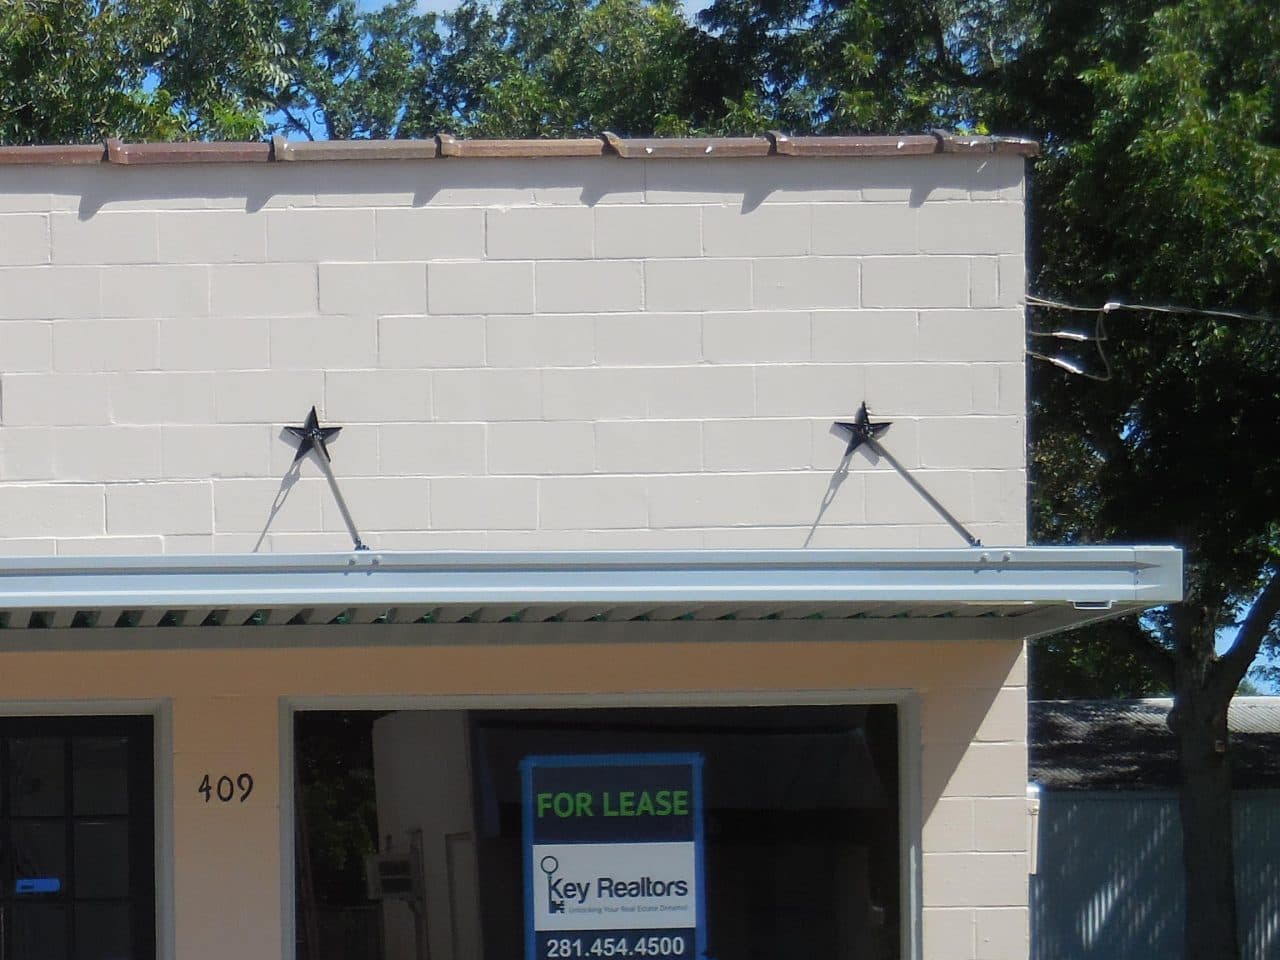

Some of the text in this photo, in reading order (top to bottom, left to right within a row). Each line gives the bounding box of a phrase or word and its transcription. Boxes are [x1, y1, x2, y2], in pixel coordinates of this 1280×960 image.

[198, 773, 253, 803] 409
[537, 790, 689, 818] FOR LEASE
[548, 875, 688, 904] Key Realtors
[547, 937, 685, 958] 281.454.4500
